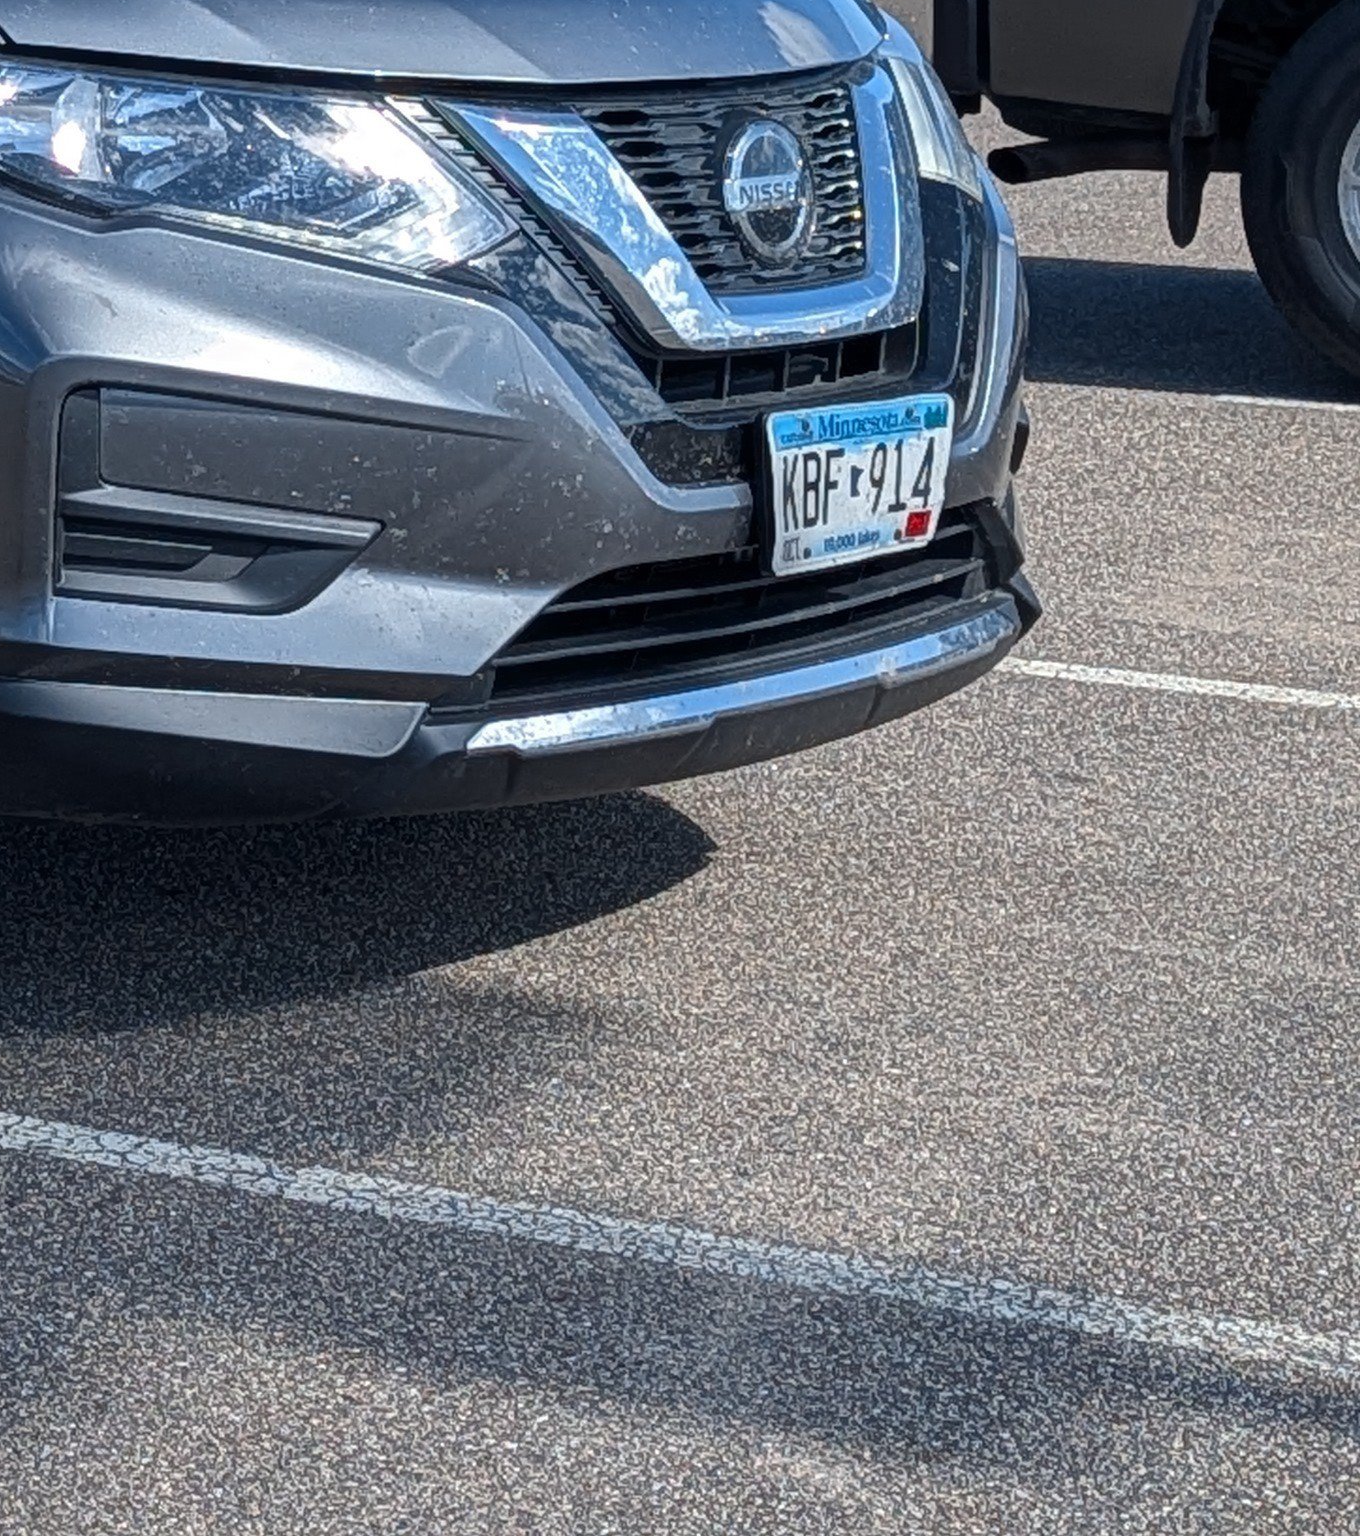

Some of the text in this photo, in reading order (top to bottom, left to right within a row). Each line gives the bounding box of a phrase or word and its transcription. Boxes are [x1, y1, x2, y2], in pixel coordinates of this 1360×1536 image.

[739, 181, 802, 204] NISSA
[782, 436, 935, 533] KBF 914
